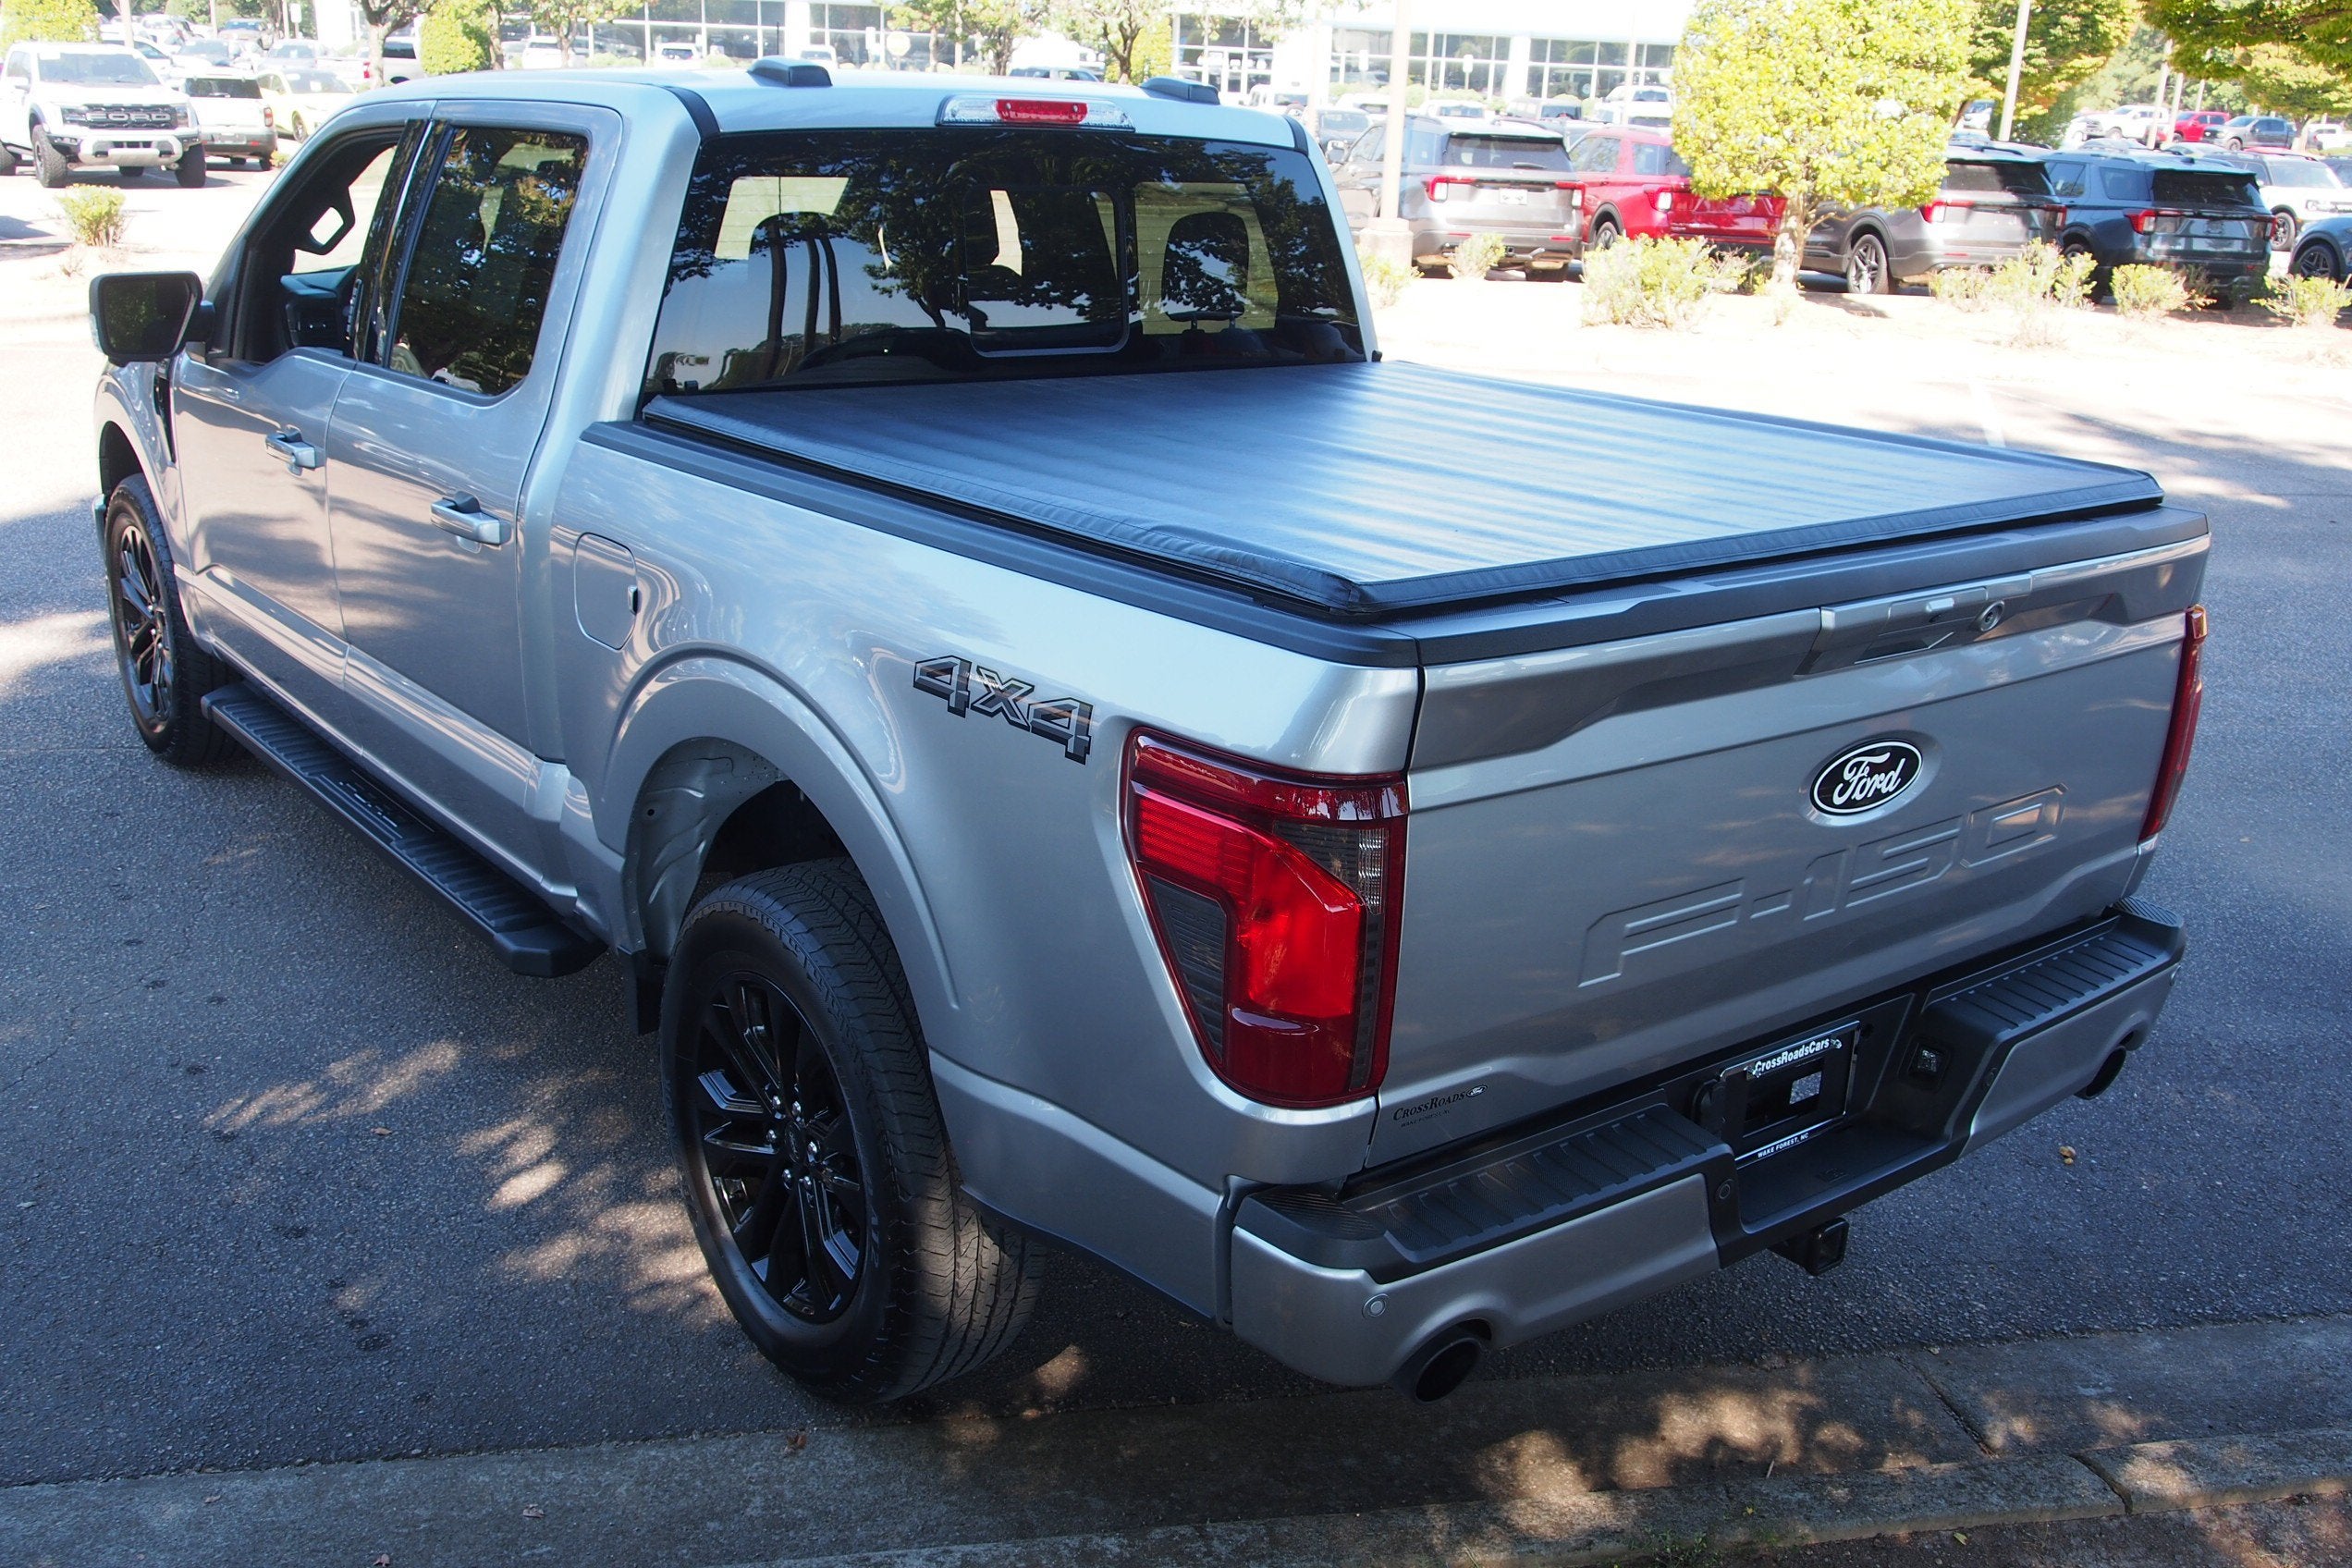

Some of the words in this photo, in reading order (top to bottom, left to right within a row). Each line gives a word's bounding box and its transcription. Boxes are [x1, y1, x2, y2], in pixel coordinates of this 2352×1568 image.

[85, 113, 172, 122] FORD
[1832, 751, 1906, 805] Ford
[1577, 782, 2068, 988] F-150
[1754, 1038, 1831, 1073] CrossRoadsCars
[1758, 1146, 1774, 1158] WAKE
